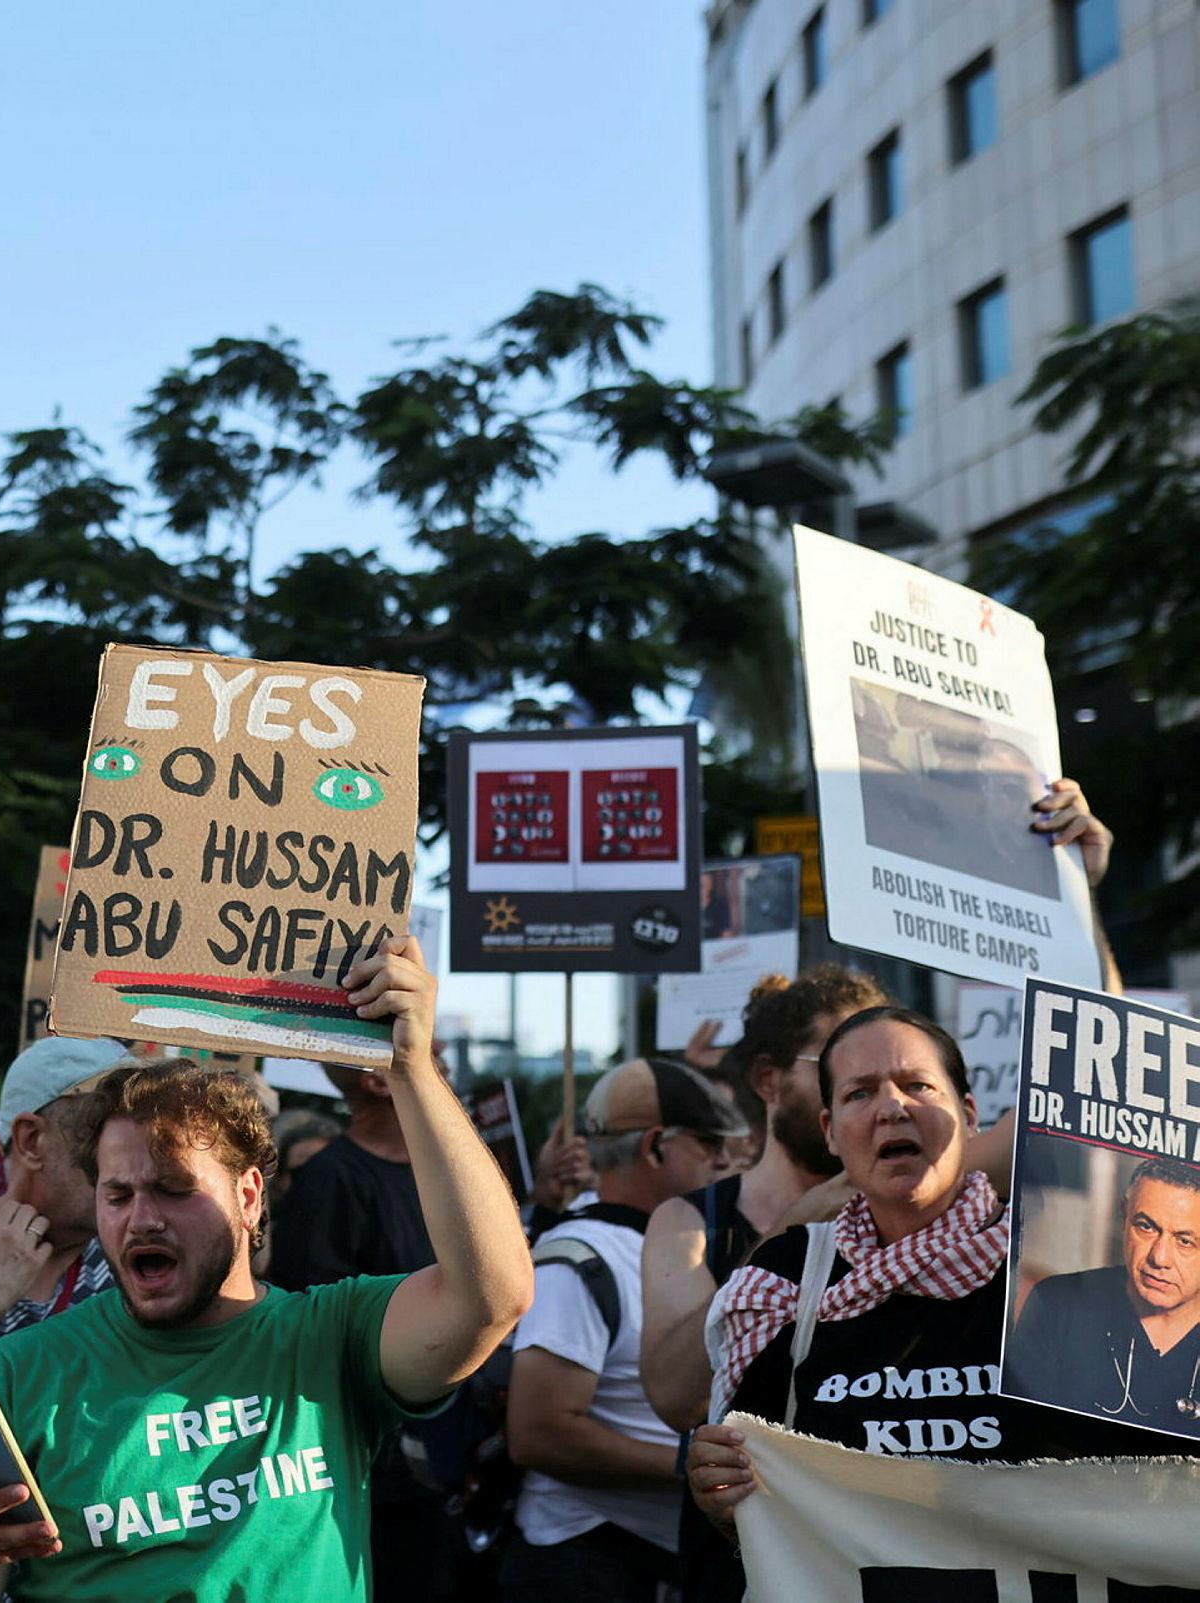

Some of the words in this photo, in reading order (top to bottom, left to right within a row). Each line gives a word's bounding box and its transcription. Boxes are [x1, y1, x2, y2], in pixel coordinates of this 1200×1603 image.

[870, 610, 948, 657] JUSTICE
[953, 637, 978, 667] TO
[124, 660, 362, 750] EYES
[853, 641, 887, 674] DR.
[893, 655, 932, 689] ABU
[937, 671, 1014, 716] SAFIYA!
[160, 746, 285, 806] ON
[73, 810, 174, 880] DR.
[201, 820, 410, 914] HUSSAM
[61, 890, 182, 960] ABU
[872, 866, 946, 909] ABOLISH
[949, 888, 983, 919] THE
[986, 900, 1052, 938] ISRAELI
[893, 909, 970, 954] TORTURE
[975, 932, 1040, 972] CAMPS
[1031, 989, 1200, 1124] FREE
[1028, 1087, 1072, 1131] DR.
[1080, 1098, 1187, 1159] HUSSAM
[146, 1395, 267, 1456] FREE
[862, 1416, 1002, 1455] KIDS
[83, 1447, 333, 1547] PALESTINE
